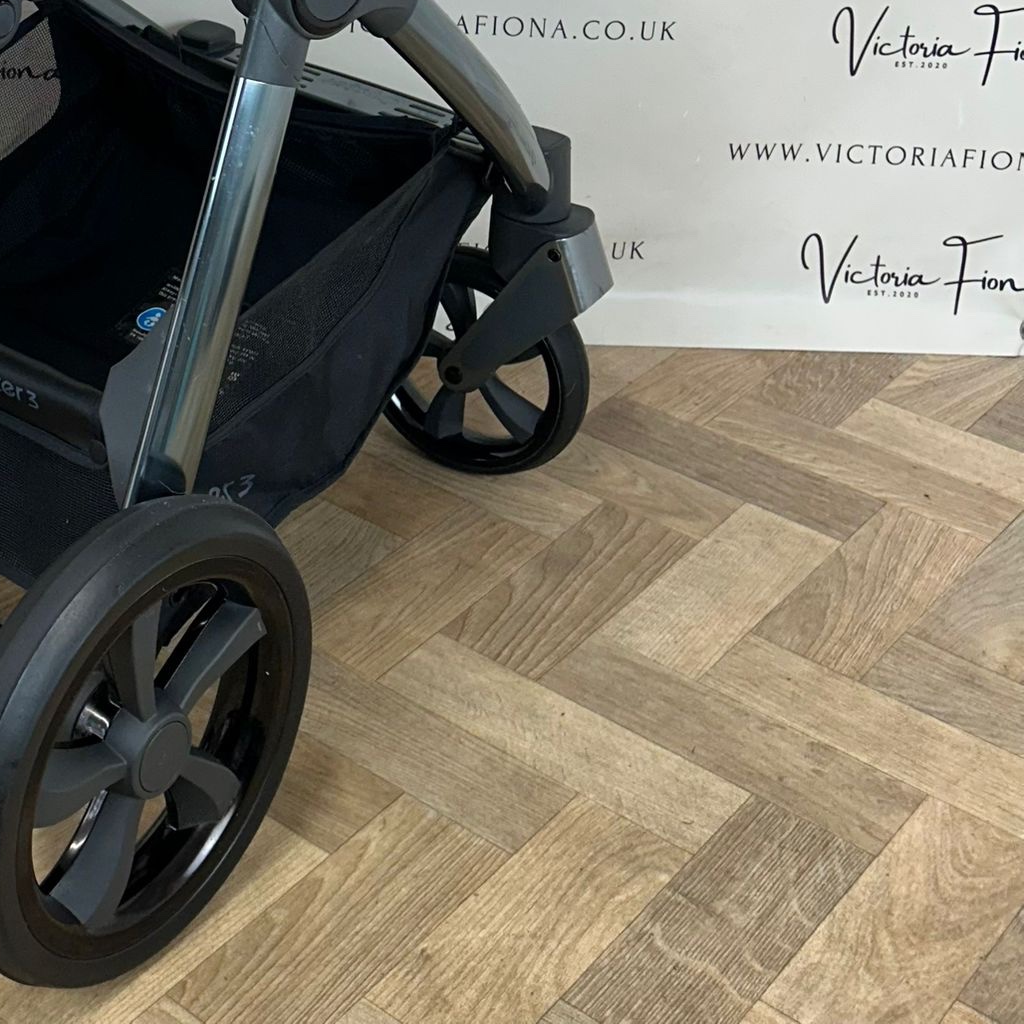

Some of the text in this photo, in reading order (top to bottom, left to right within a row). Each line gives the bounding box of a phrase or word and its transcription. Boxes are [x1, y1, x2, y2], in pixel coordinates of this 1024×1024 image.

[350, 15, 676, 41] AFIONA.CO.UK
[832, 6, 971, 77] Victoria
[895, 61, 947, 69] EST.2020
[801, 233, 941, 304] Victoria
[867, 290, 919, 298] EST.2020
